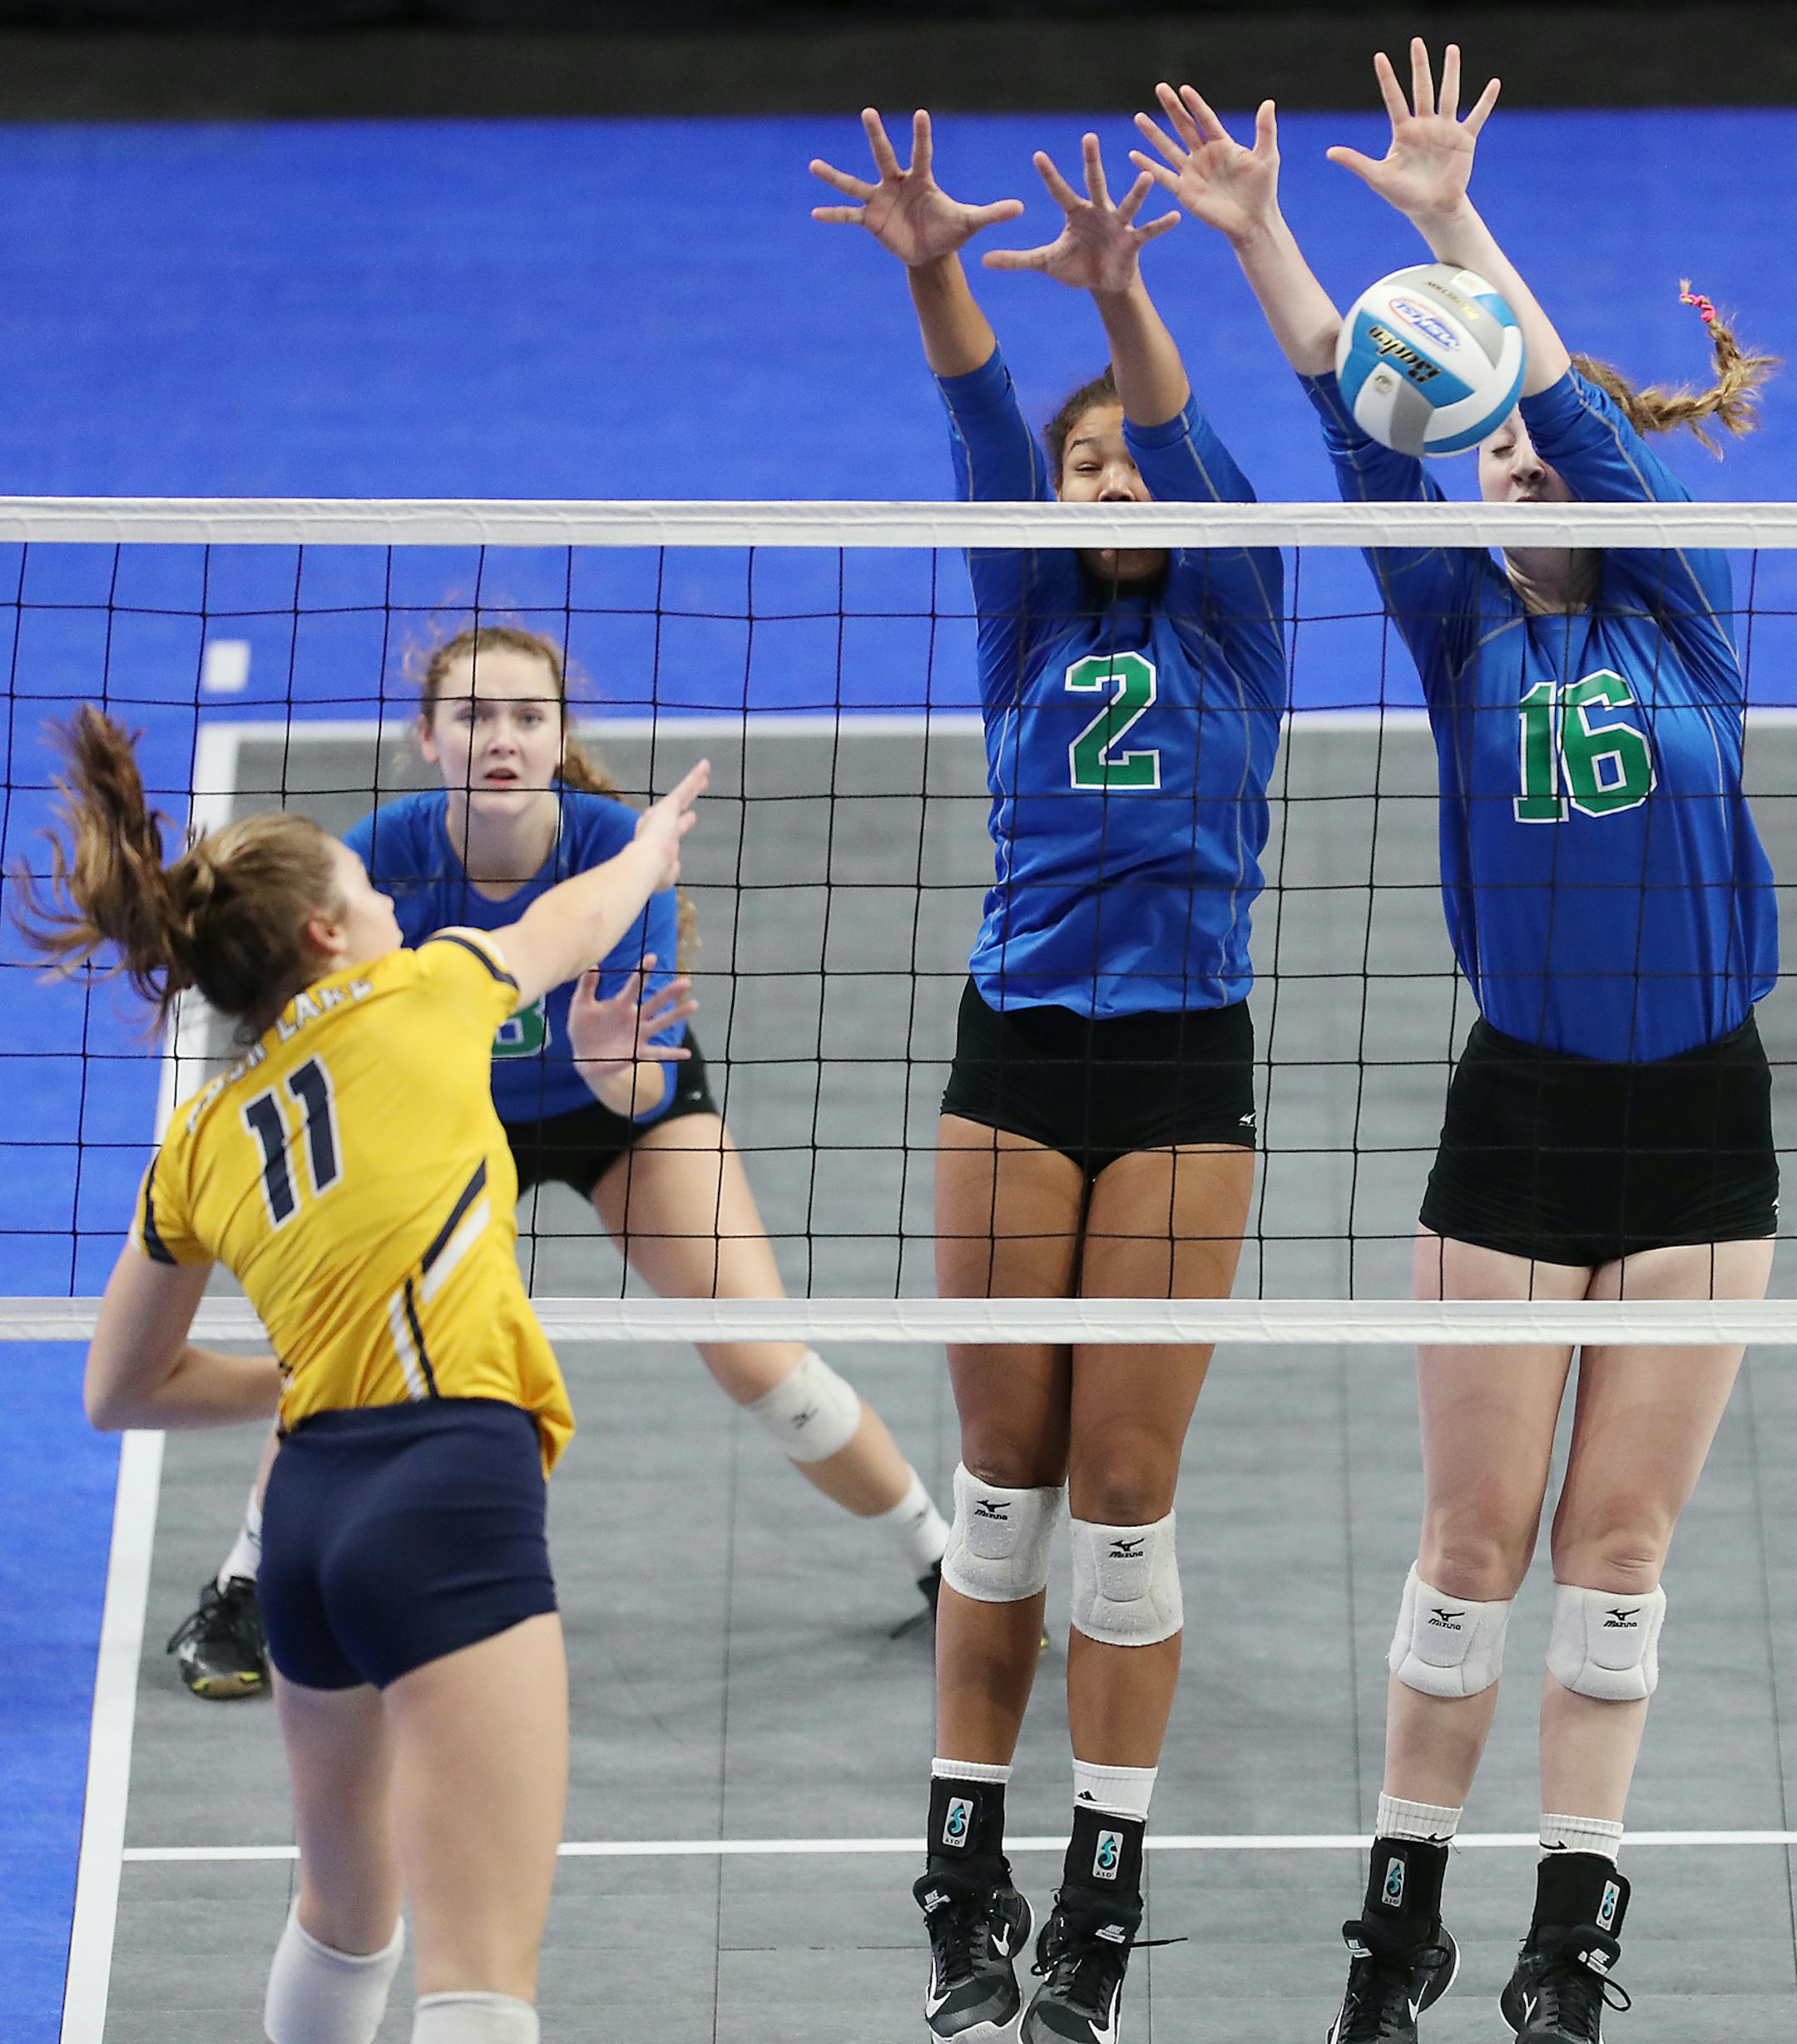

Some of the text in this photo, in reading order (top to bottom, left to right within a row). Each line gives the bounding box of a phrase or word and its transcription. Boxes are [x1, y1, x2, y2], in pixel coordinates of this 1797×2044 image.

[1369, 325, 1442, 383] Baden
[1065, 651, 1160, 790] 2
[1513, 668, 1657, 824] 16
[240, 1051, 343, 1232] 11
[974, 1510, 1007, 1521] Mizuno
[1428, 1618, 1461, 1631] Mizuno
